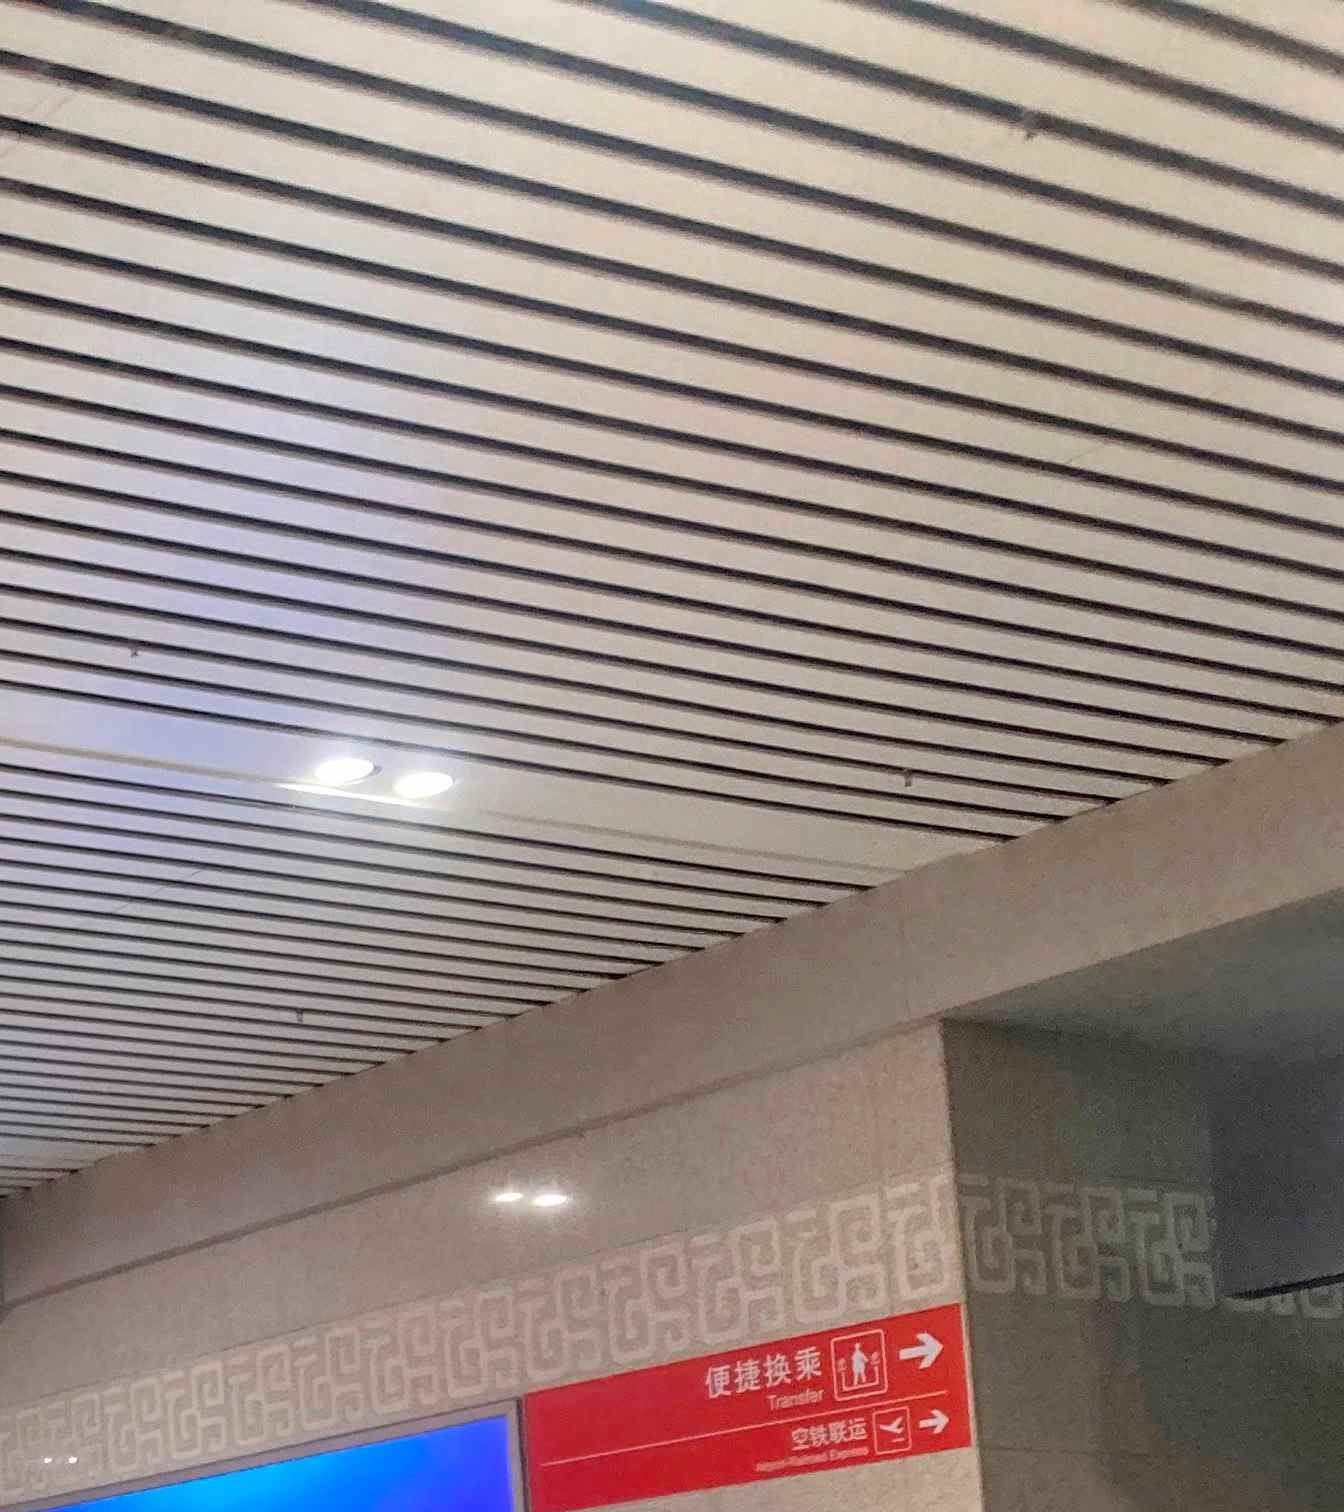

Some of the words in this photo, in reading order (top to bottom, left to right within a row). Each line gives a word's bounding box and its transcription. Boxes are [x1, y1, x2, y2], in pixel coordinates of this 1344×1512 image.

[706, 1347, 822, 1398] 便捷换乘
[767, 1390, 824, 1410] Transfer
[792, 1418, 867, 1450] 空铁联运
